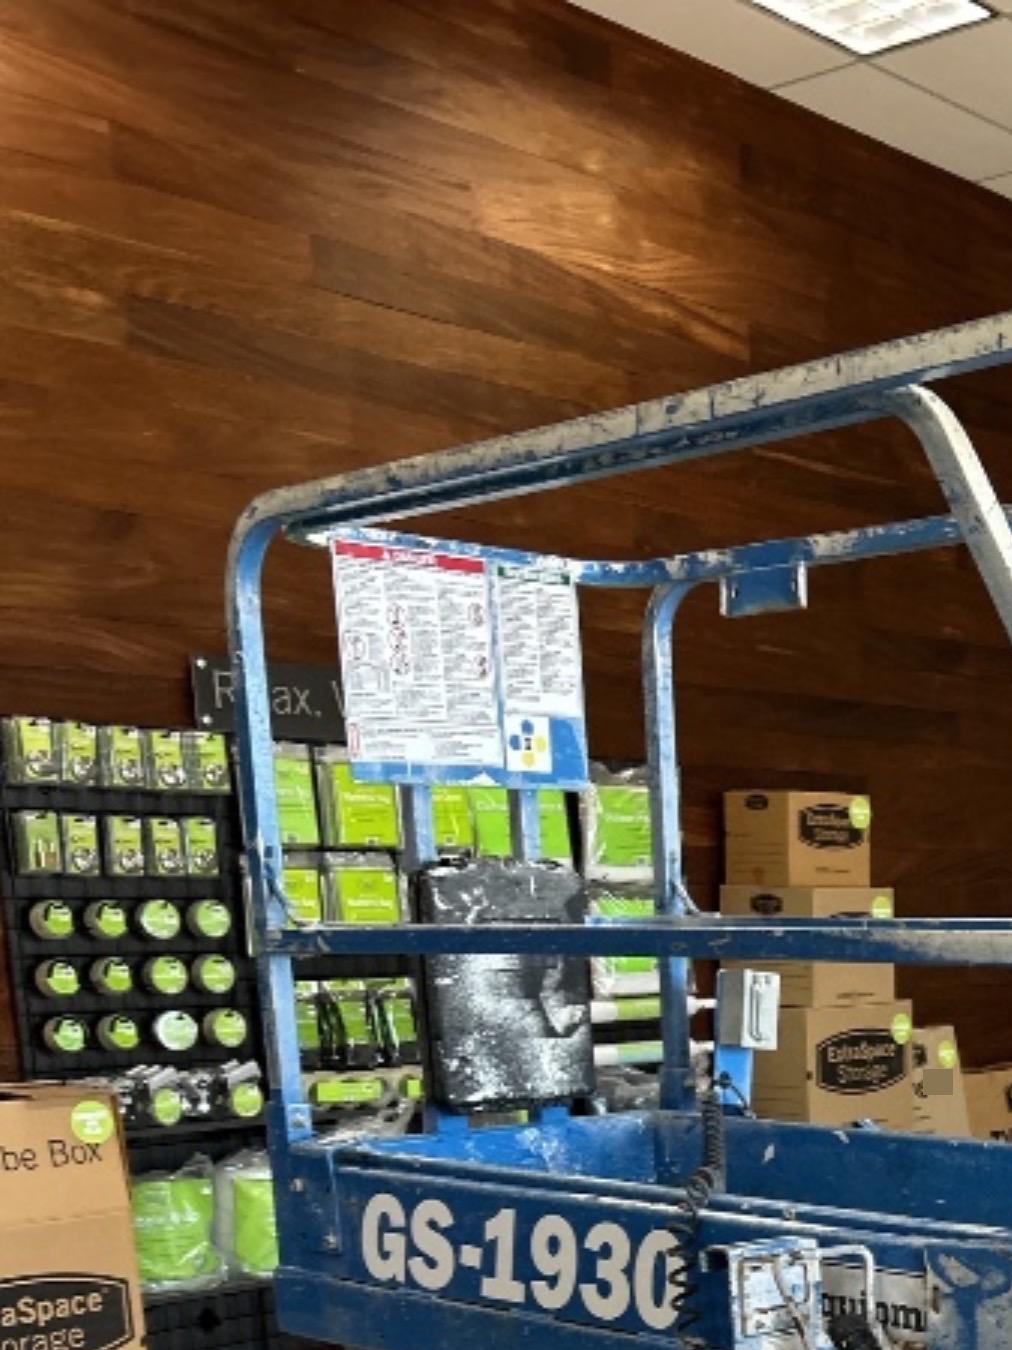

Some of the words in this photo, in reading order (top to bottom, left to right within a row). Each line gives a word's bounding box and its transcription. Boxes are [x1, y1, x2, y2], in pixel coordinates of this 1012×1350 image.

[213, 670, 322, 718] Rax.
[47, 1138, 102, 1168] Box
[361, 1192, 686, 1330] GS-1930
[1, 1291, 103, 1327] aSpace
